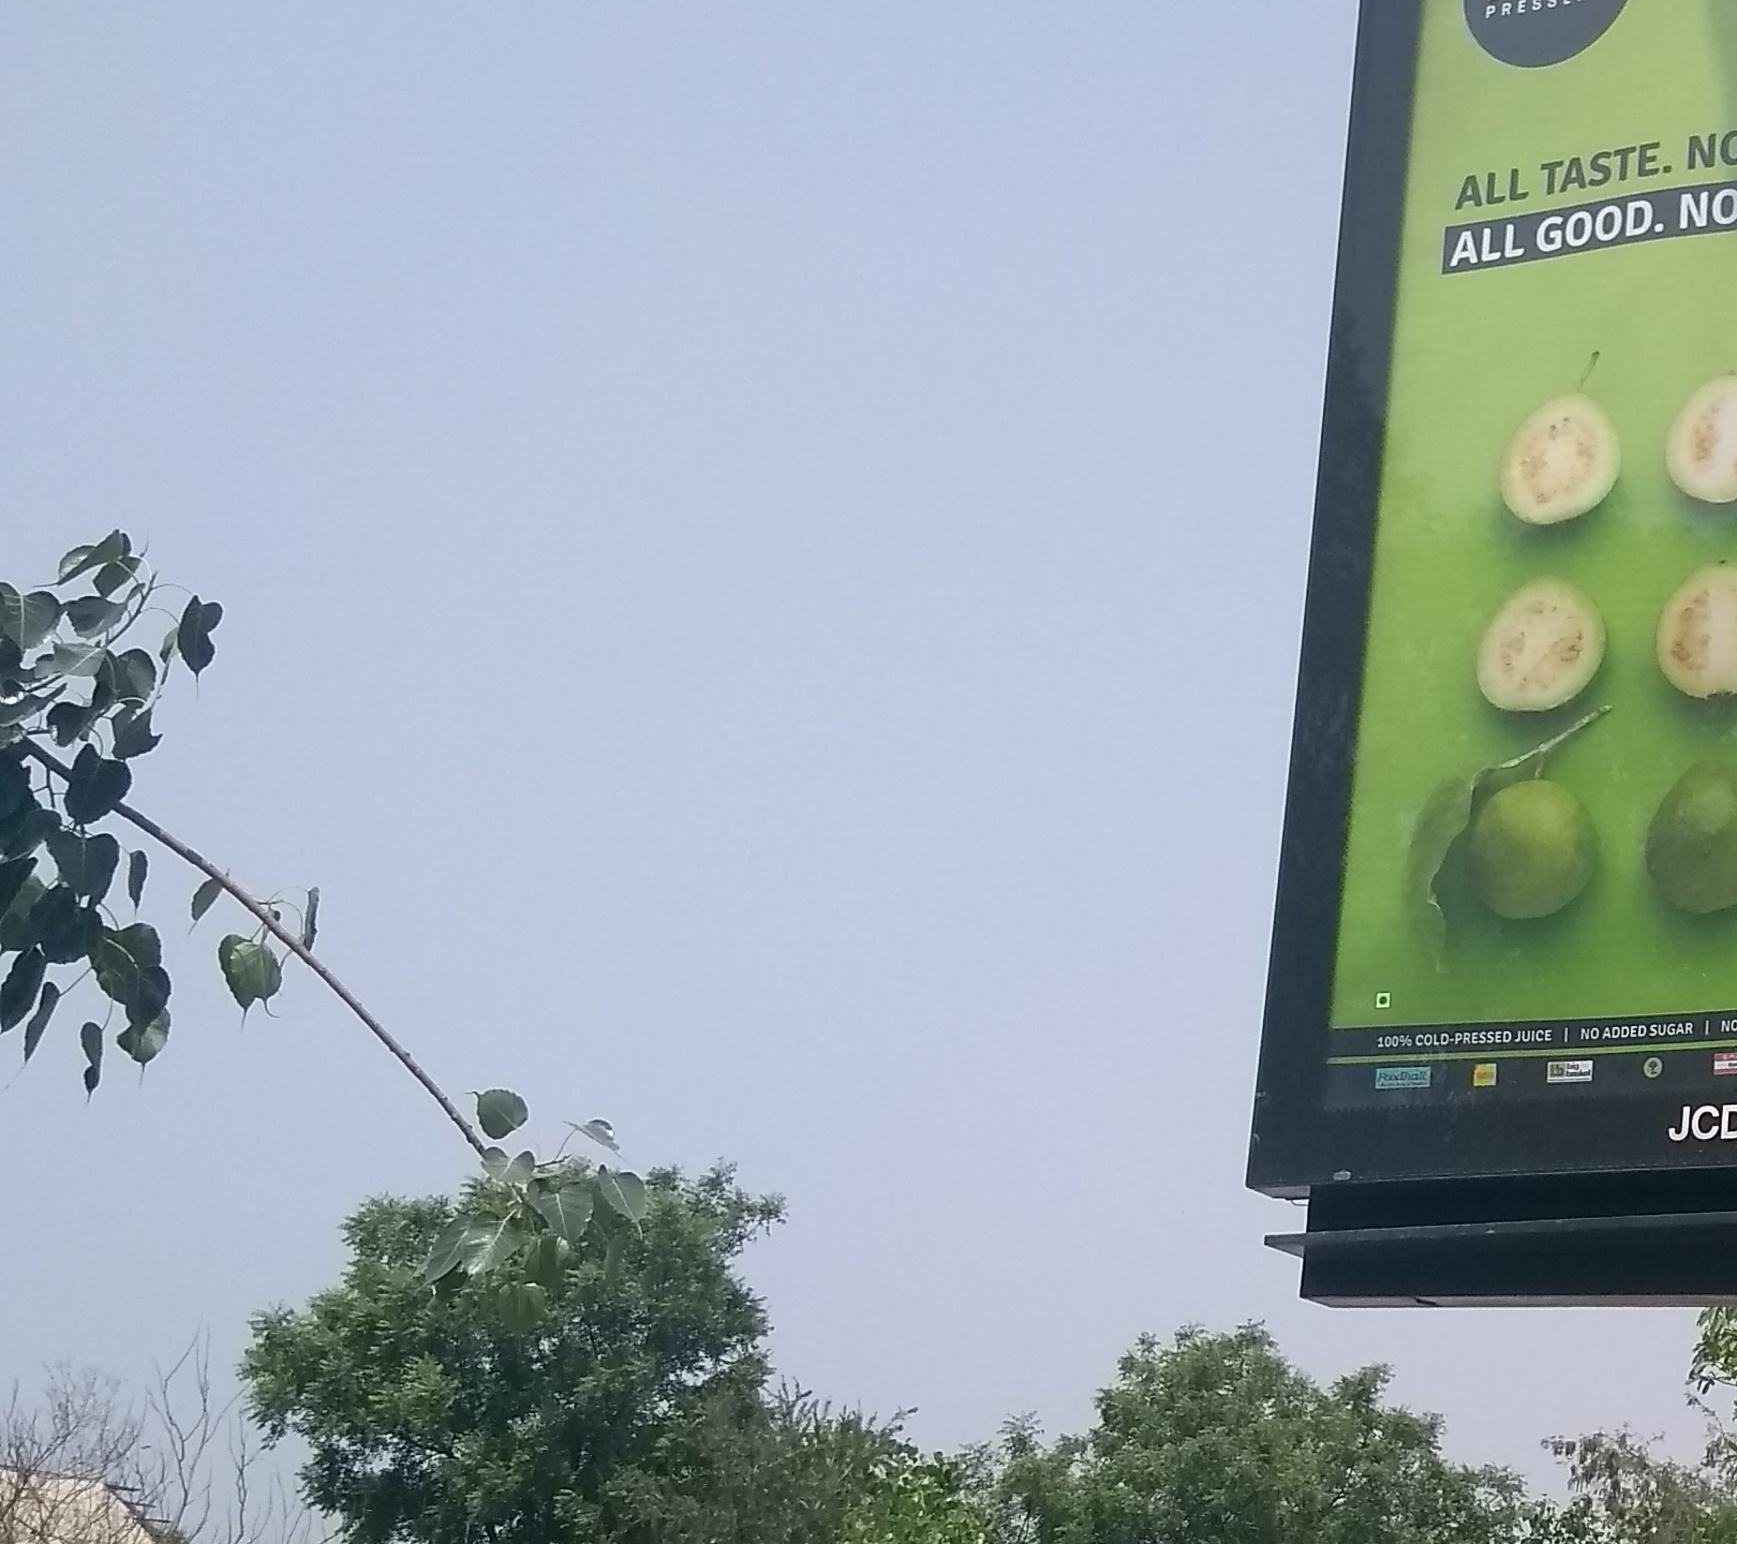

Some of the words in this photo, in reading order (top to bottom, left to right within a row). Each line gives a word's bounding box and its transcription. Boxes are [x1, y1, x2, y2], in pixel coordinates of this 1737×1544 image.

[1455, 168, 1529, 210] ALL
[1540, 141, 1673, 195] TASTE.
[1449, 224, 1525, 267] ALL
[1535, 200, 1665, 253] GOOD.
[1377, 1035, 1413, 1048] 100%
[1415, 1030, 1513, 1046] COLD-PRESSED
[1514, 1029, 1553, 1043] JUICE
[1580, 1027, 1600, 1040] NO
[1602, 1024, 1648, 1039] ADDED
[1649, 1022, 1694, 1036] SUGAR
